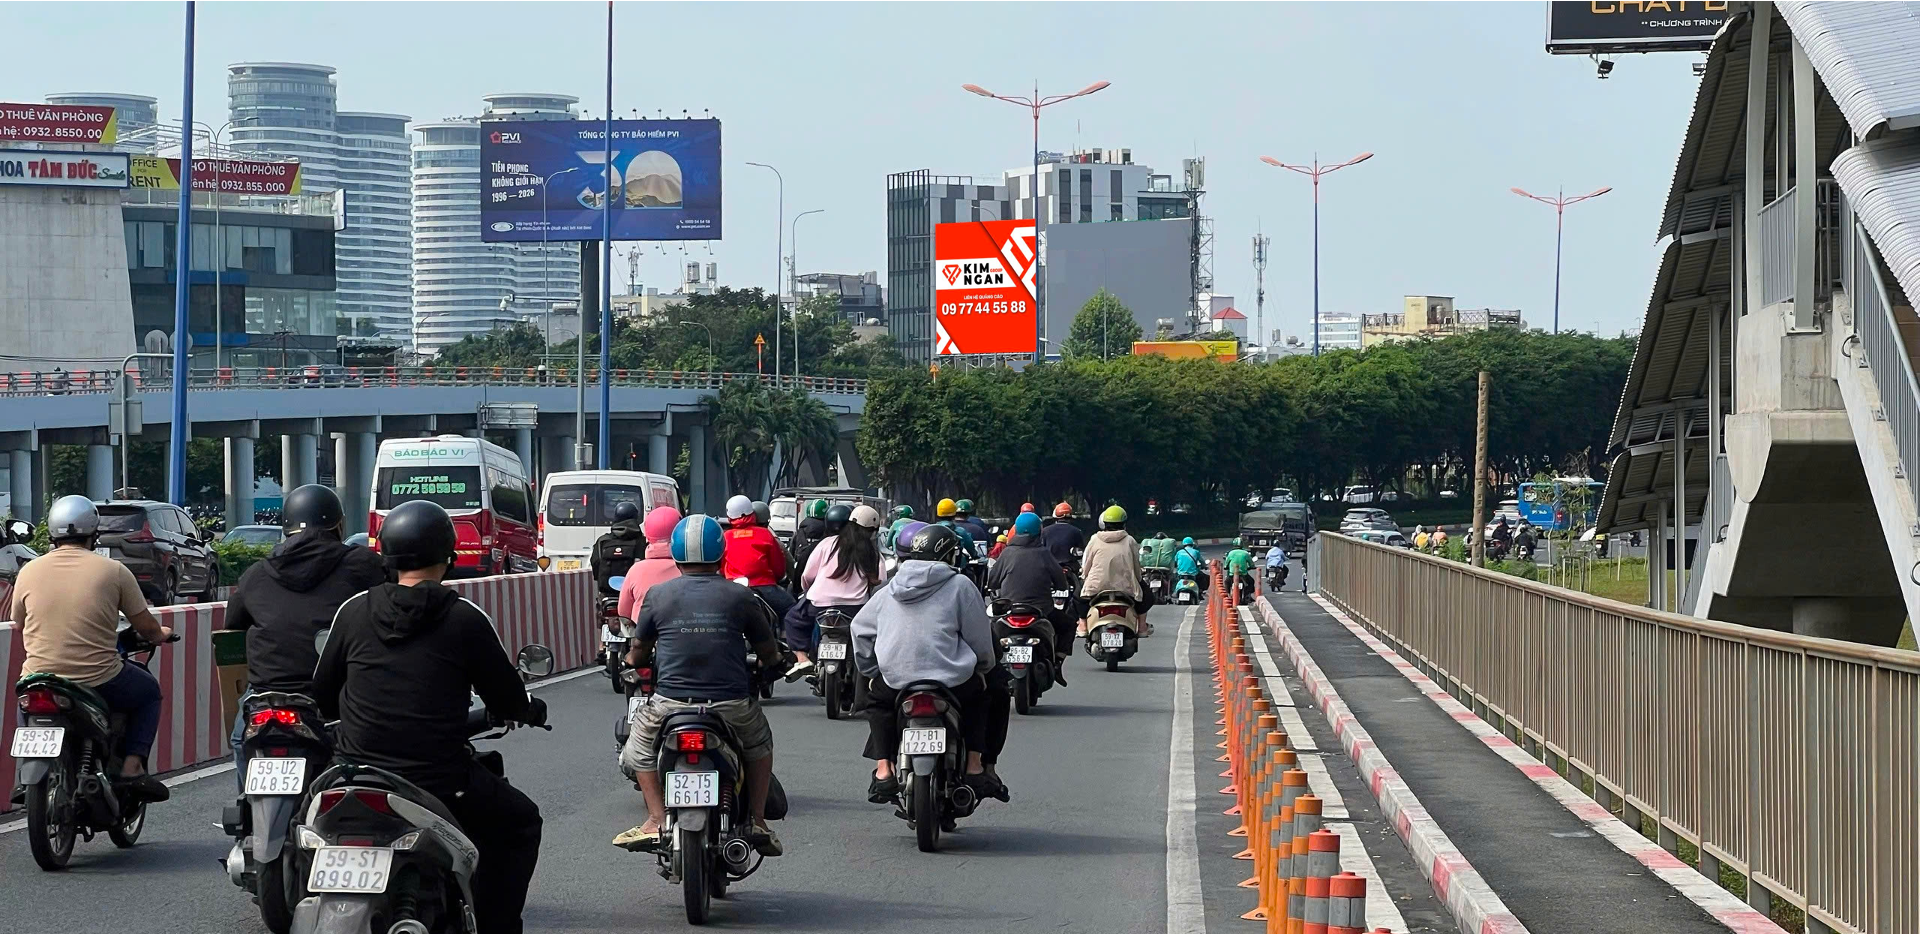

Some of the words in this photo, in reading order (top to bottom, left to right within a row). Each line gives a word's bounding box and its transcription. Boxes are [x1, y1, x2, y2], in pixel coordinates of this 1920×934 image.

[1693, 17, 1723, 26] TRÌNH
[6, 108, 35, 120] THUÊ
[36, 109, 60, 120] VĂN
[62, 110, 104, 122] PHÒNG
[4, 126, 20, 138] hệ:
[578, 130, 598, 138] TỔNG
[632, 129, 646, 138] BẢO
[647, 129, 665, 138] HIỂM
[0, 160, 24, 178] HOA
[28, 158, 62, 178] TÂM
[131, 158, 157, 168] FFICE
[192, 162, 206, 171] HO
[208, 161, 231, 173] THUÊ
[232, 161, 251, 174] VĂN
[252, 163, 285, 175] PHÒNG
[507, 164, 529, 173] PHONG
[130, 176, 161, 187] RENT
[192, 178, 204, 188] ên
[221, 180, 285, 192] 0932.855.000
[492, 176, 514, 187] KHÔNG
[492, 192, 507, 202] 1996
[518, 189, 534, 198] 2026
[964, 263, 989, 274] KIM
[964, 274, 1003, 285] NGAN
[942, 303, 957, 315] 09
[959, 303, 973, 314] 77
[975, 302, 990, 314] 44
[992, 301, 1008, 313] 55
[1011, 301, 1026, 313] 88
[392, 484, 420, 494] 0772
[22, 731, 55, 741] 59-SA
[910, 731, 937, 740] 71-B1
[19, 743, 57, 754] 144.42
[906, 742, 942, 752] 122.69
[258, 761, 296, 774] 59-U2
[251, 777, 299, 791] 048.52
[674, 774, 710, 789] 52-T5
[675, 790, 710, 804] 6613
[326, 850, 378, 868] 59-S1
[315, 870, 383, 889] 899.02
